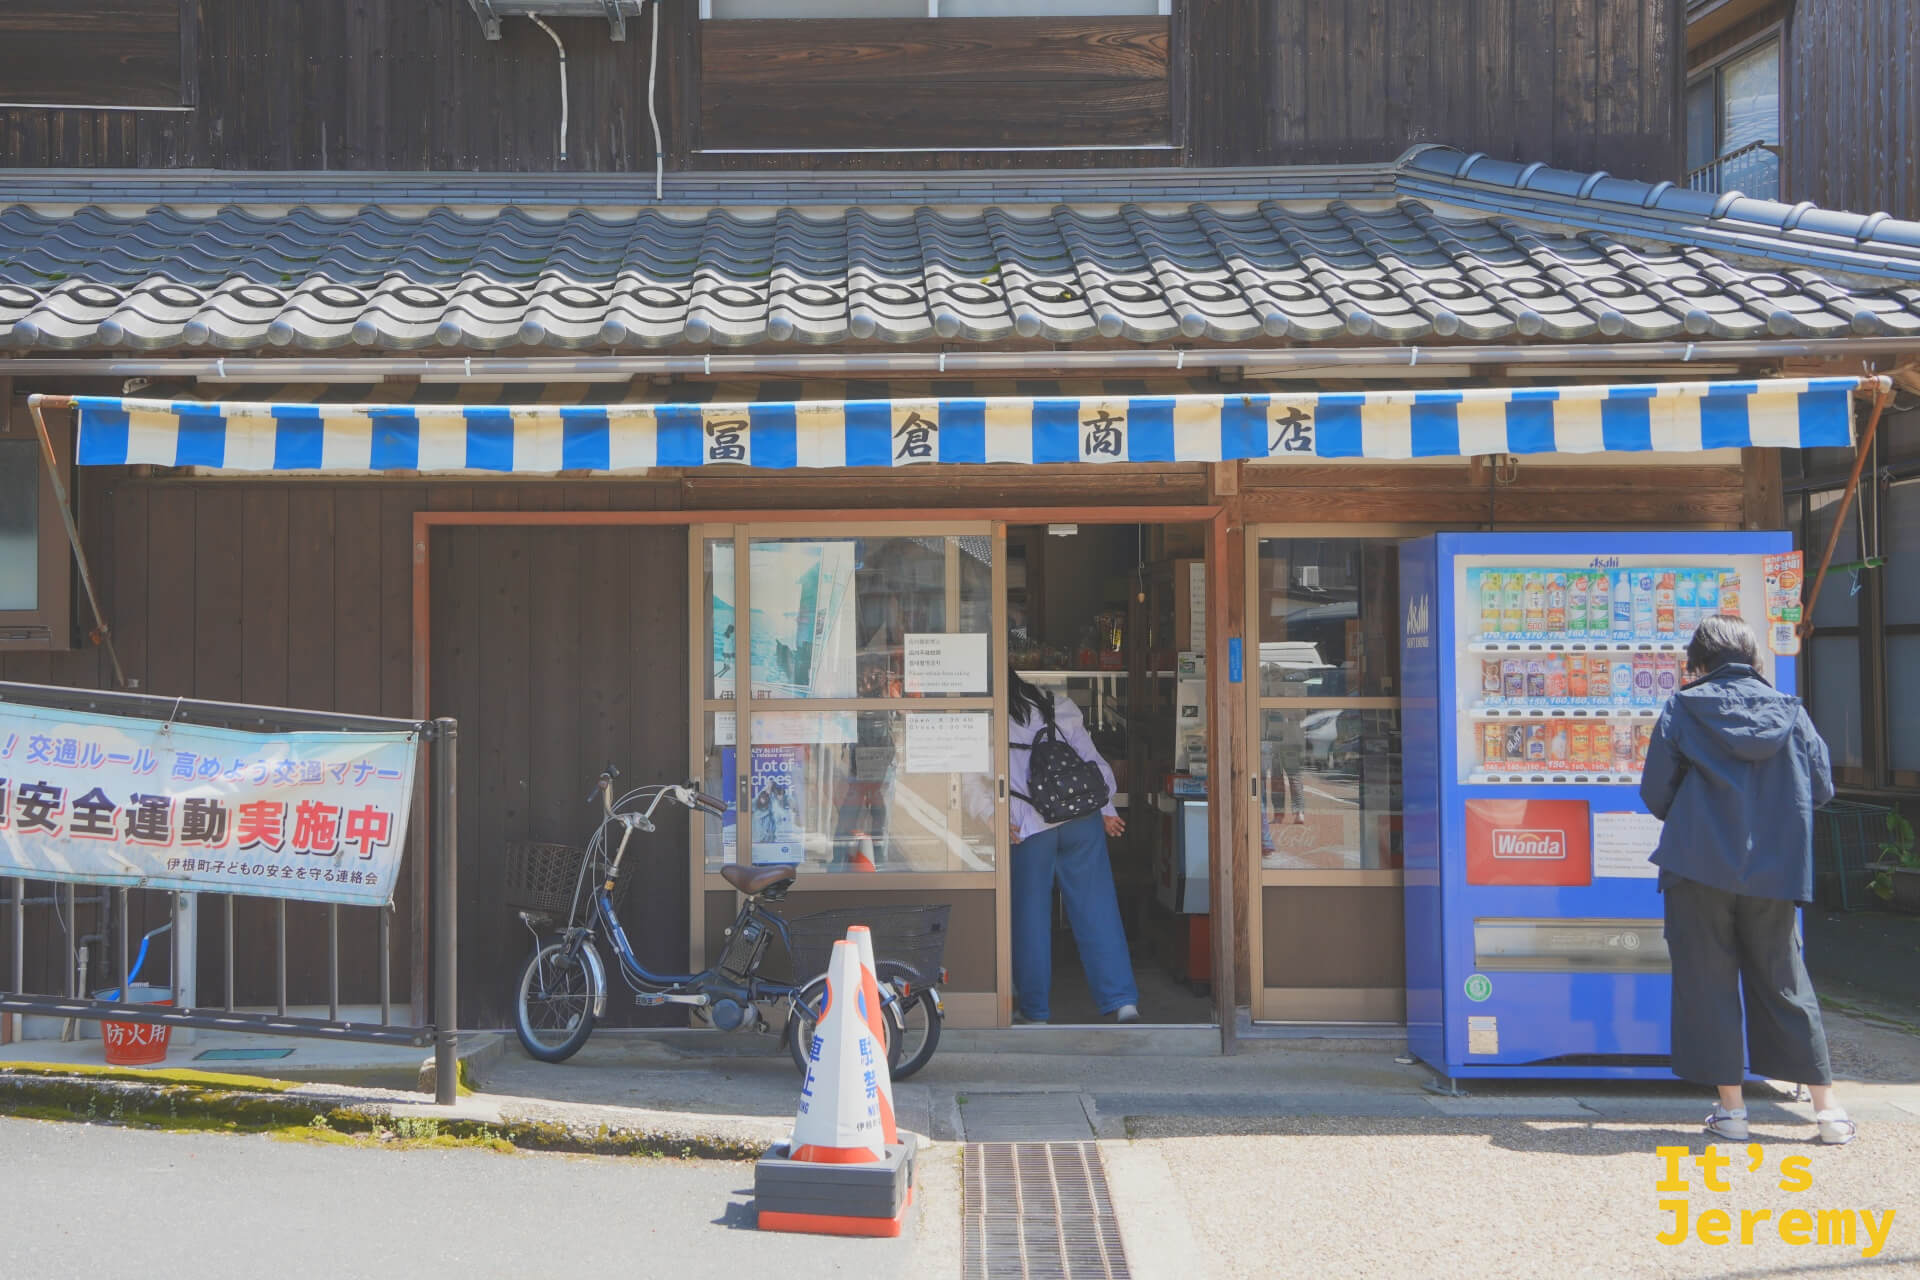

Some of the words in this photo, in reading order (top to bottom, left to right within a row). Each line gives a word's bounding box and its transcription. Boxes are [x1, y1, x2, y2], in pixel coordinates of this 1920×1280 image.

[1589, 555, 1619, 568] Asahi
[1406, 592, 1429, 634] Asahi
[26, 733, 157, 774] 交通ルール
[170, 751, 402, 785] 高めよう交通マナー
[754, 759, 778, 772] Lot
[780, 759, 795, 772] of
[751, 773, 792, 786] choes
[0, 777, 392, 858] 安全運動実施中
[1498, 834, 1560, 855] Wonda
[167, 857, 379, 885] 伊根町子どもの安全を守る連絡会
[106, 1023, 166, 1046] 防火用
